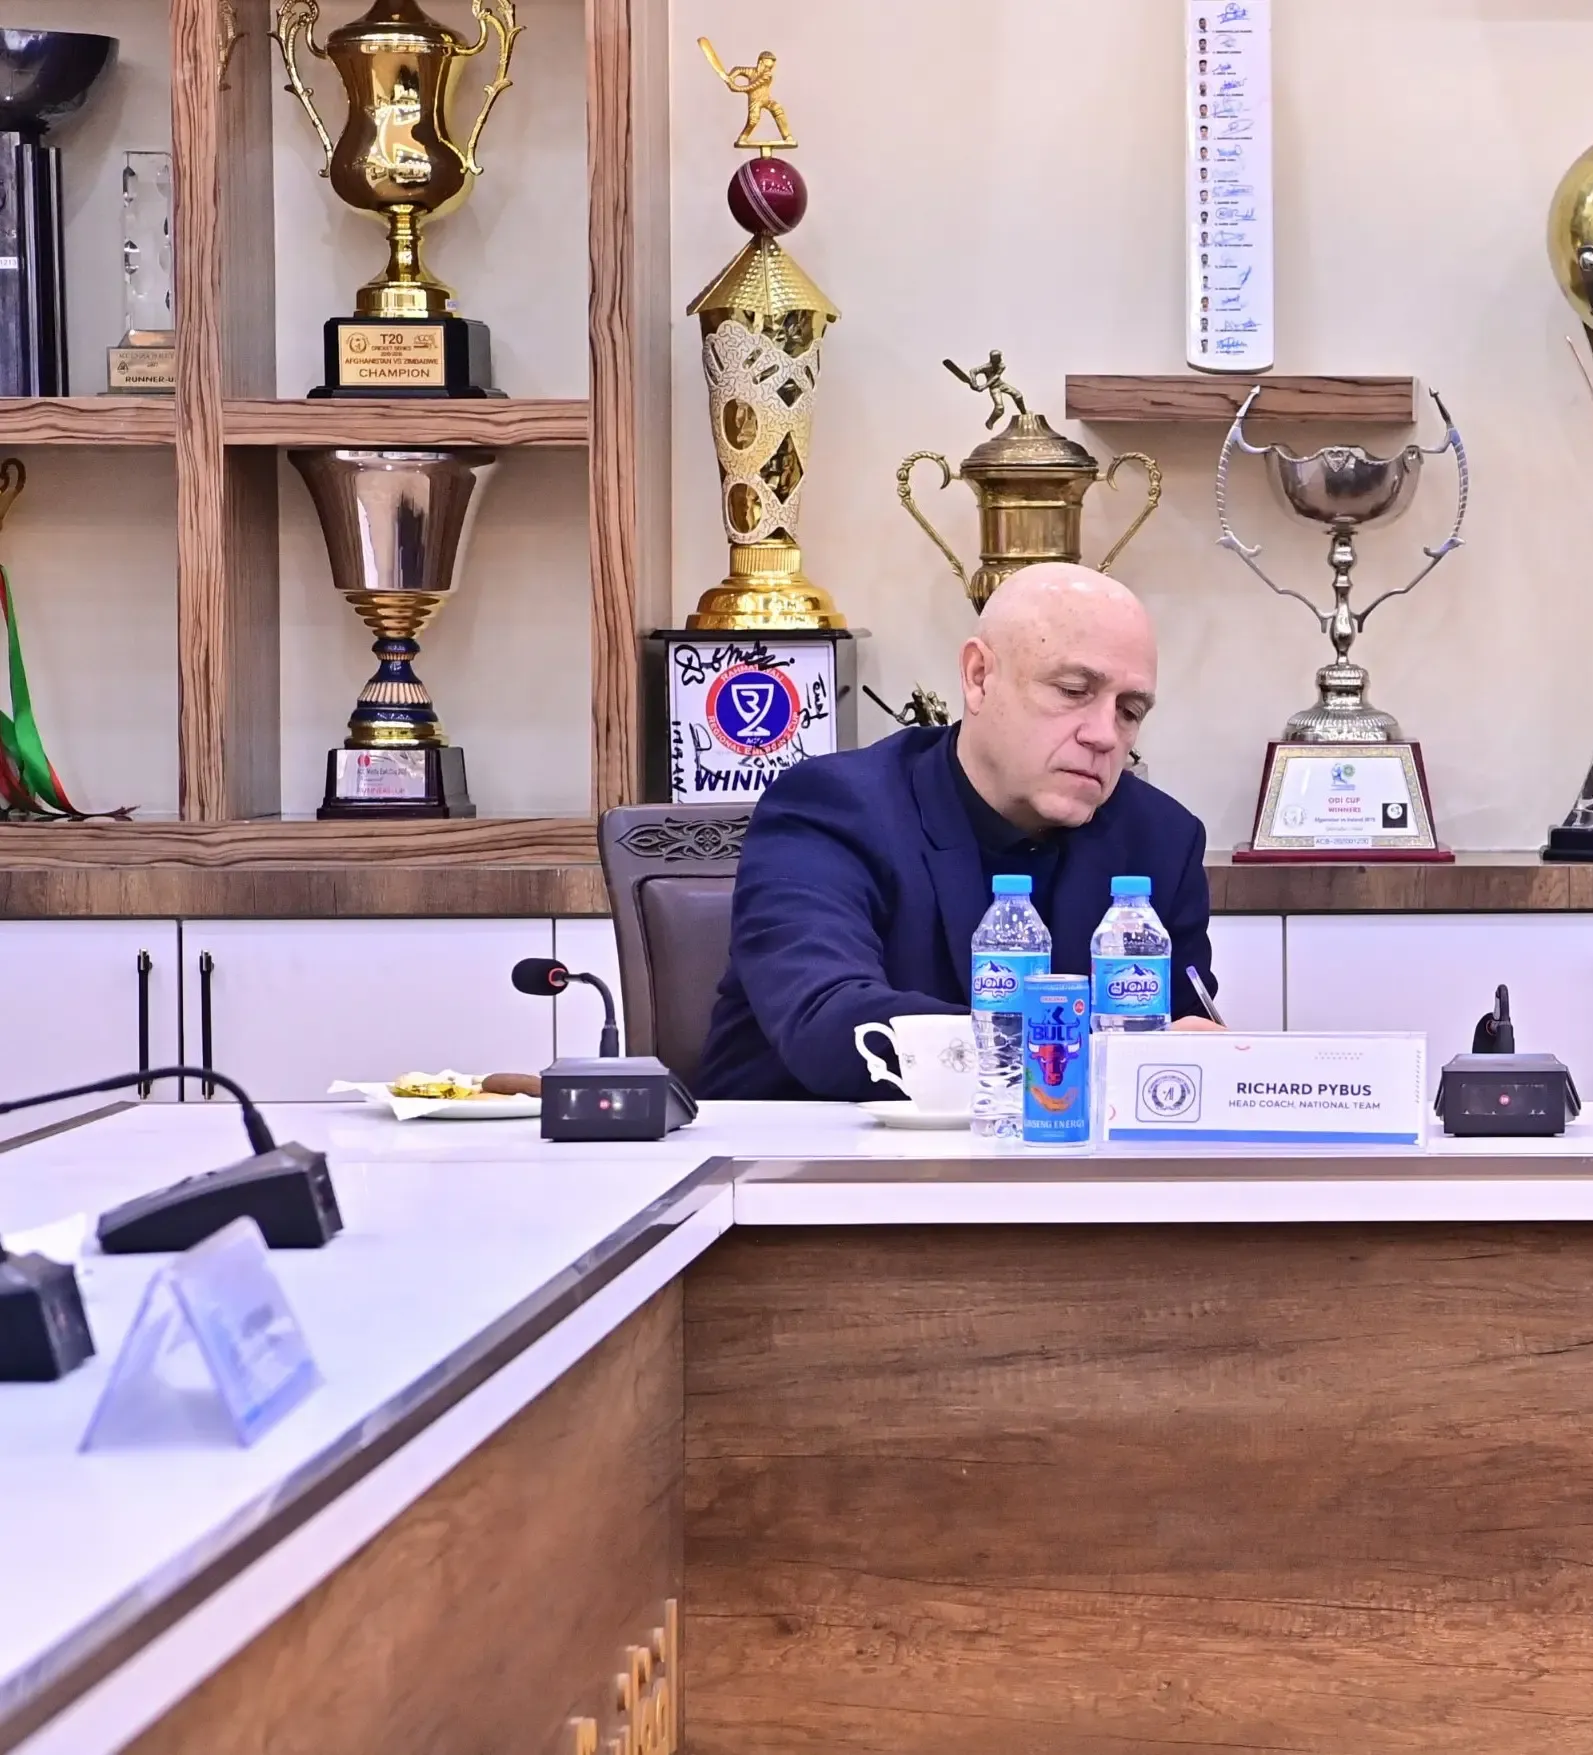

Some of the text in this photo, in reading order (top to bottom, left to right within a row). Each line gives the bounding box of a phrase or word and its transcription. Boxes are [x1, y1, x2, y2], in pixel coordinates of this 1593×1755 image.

[380, 333, 404, 345] T20
[359, 368, 430, 378] CHAMPION
[706, 714, 742, 755] REGIONAL
[1328, 796, 1361, 804] ODI CUP
[1109, 979, 1159, 1000] میهن
[1033, 1025, 1075, 1041] BULL
[1236, 1082, 1372, 1097] RICHARD PYBUS
[1228, 1099, 1256, 1108] HEAD
[1299, 1100, 1350, 1109] NATIONAL
[1353, 1101, 1381, 1110] TEAM
